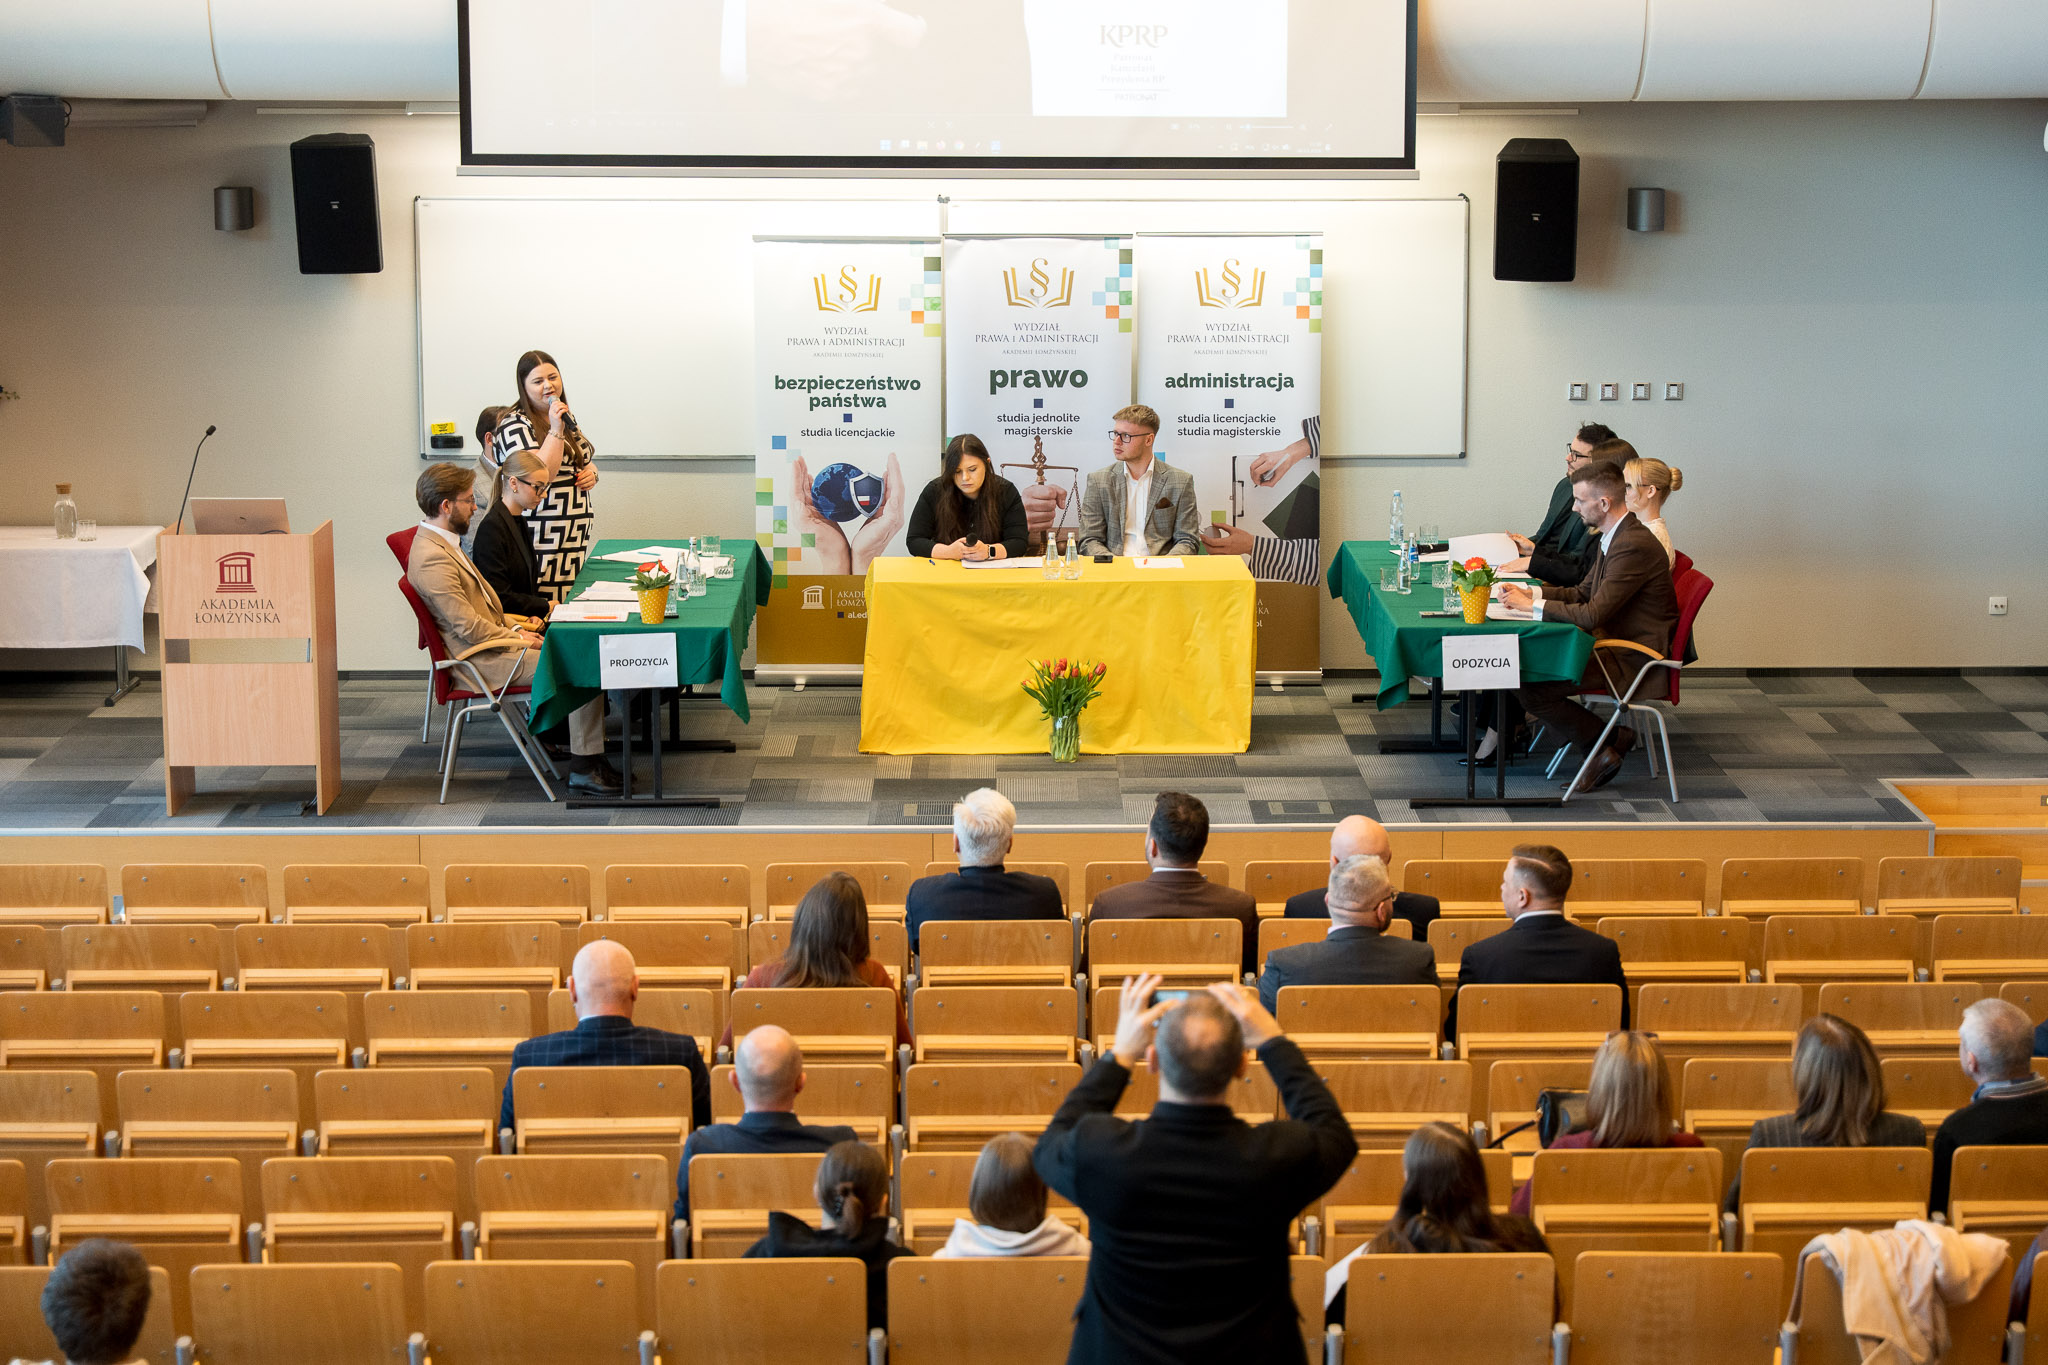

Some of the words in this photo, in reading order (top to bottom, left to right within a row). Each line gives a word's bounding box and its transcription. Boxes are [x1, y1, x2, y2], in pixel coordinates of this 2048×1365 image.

[1100, 24, 1168, 48] KPRP
[824, 327, 868, 335] WYDZIAŁ
[1013, 323, 1060, 331] WYDZIAŁ
[1205, 323, 1252, 331] WYDZIAŁ
[787, 337, 820, 346] PRAWA
[829, 337, 905, 348] ADMINISTRACJI
[975, 334, 1010, 343] PRAWA
[1018, 334, 1099, 344] ADMINISTRACJI
[1167, 334, 1201, 343] PRAWA
[1210, 334, 1290, 344] ADMINISTRACJI
[774, 375, 921, 393] bezpieczeństwo
[990, 369, 1088, 395] prawo
[1165, 371, 1295, 392] administracja
[809, 392, 887, 411] państwa
[997, 413, 1030, 423] studia
[1032, 413, 1080, 424] jednolite
[1177, 414, 1210, 423] studia
[1213, 413, 1276, 426] licencjackie
[801, 427, 832, 437] studia
[835, 427, 895, 439] licencjackie
[1004, 427, 1073, 438] magisterskie
[1177, 426, 1210, 436] studia
[1213, 426, 1281, 439] magisterskie
[200, 599, 274, 611] AKADEMIA
[195, 610, 281, 624] ŁOMŻYŃSKA
[610, 658, 669, 667] PROPOZYCJA
[1452, 658, 1511, 668] OPOZYCJA
